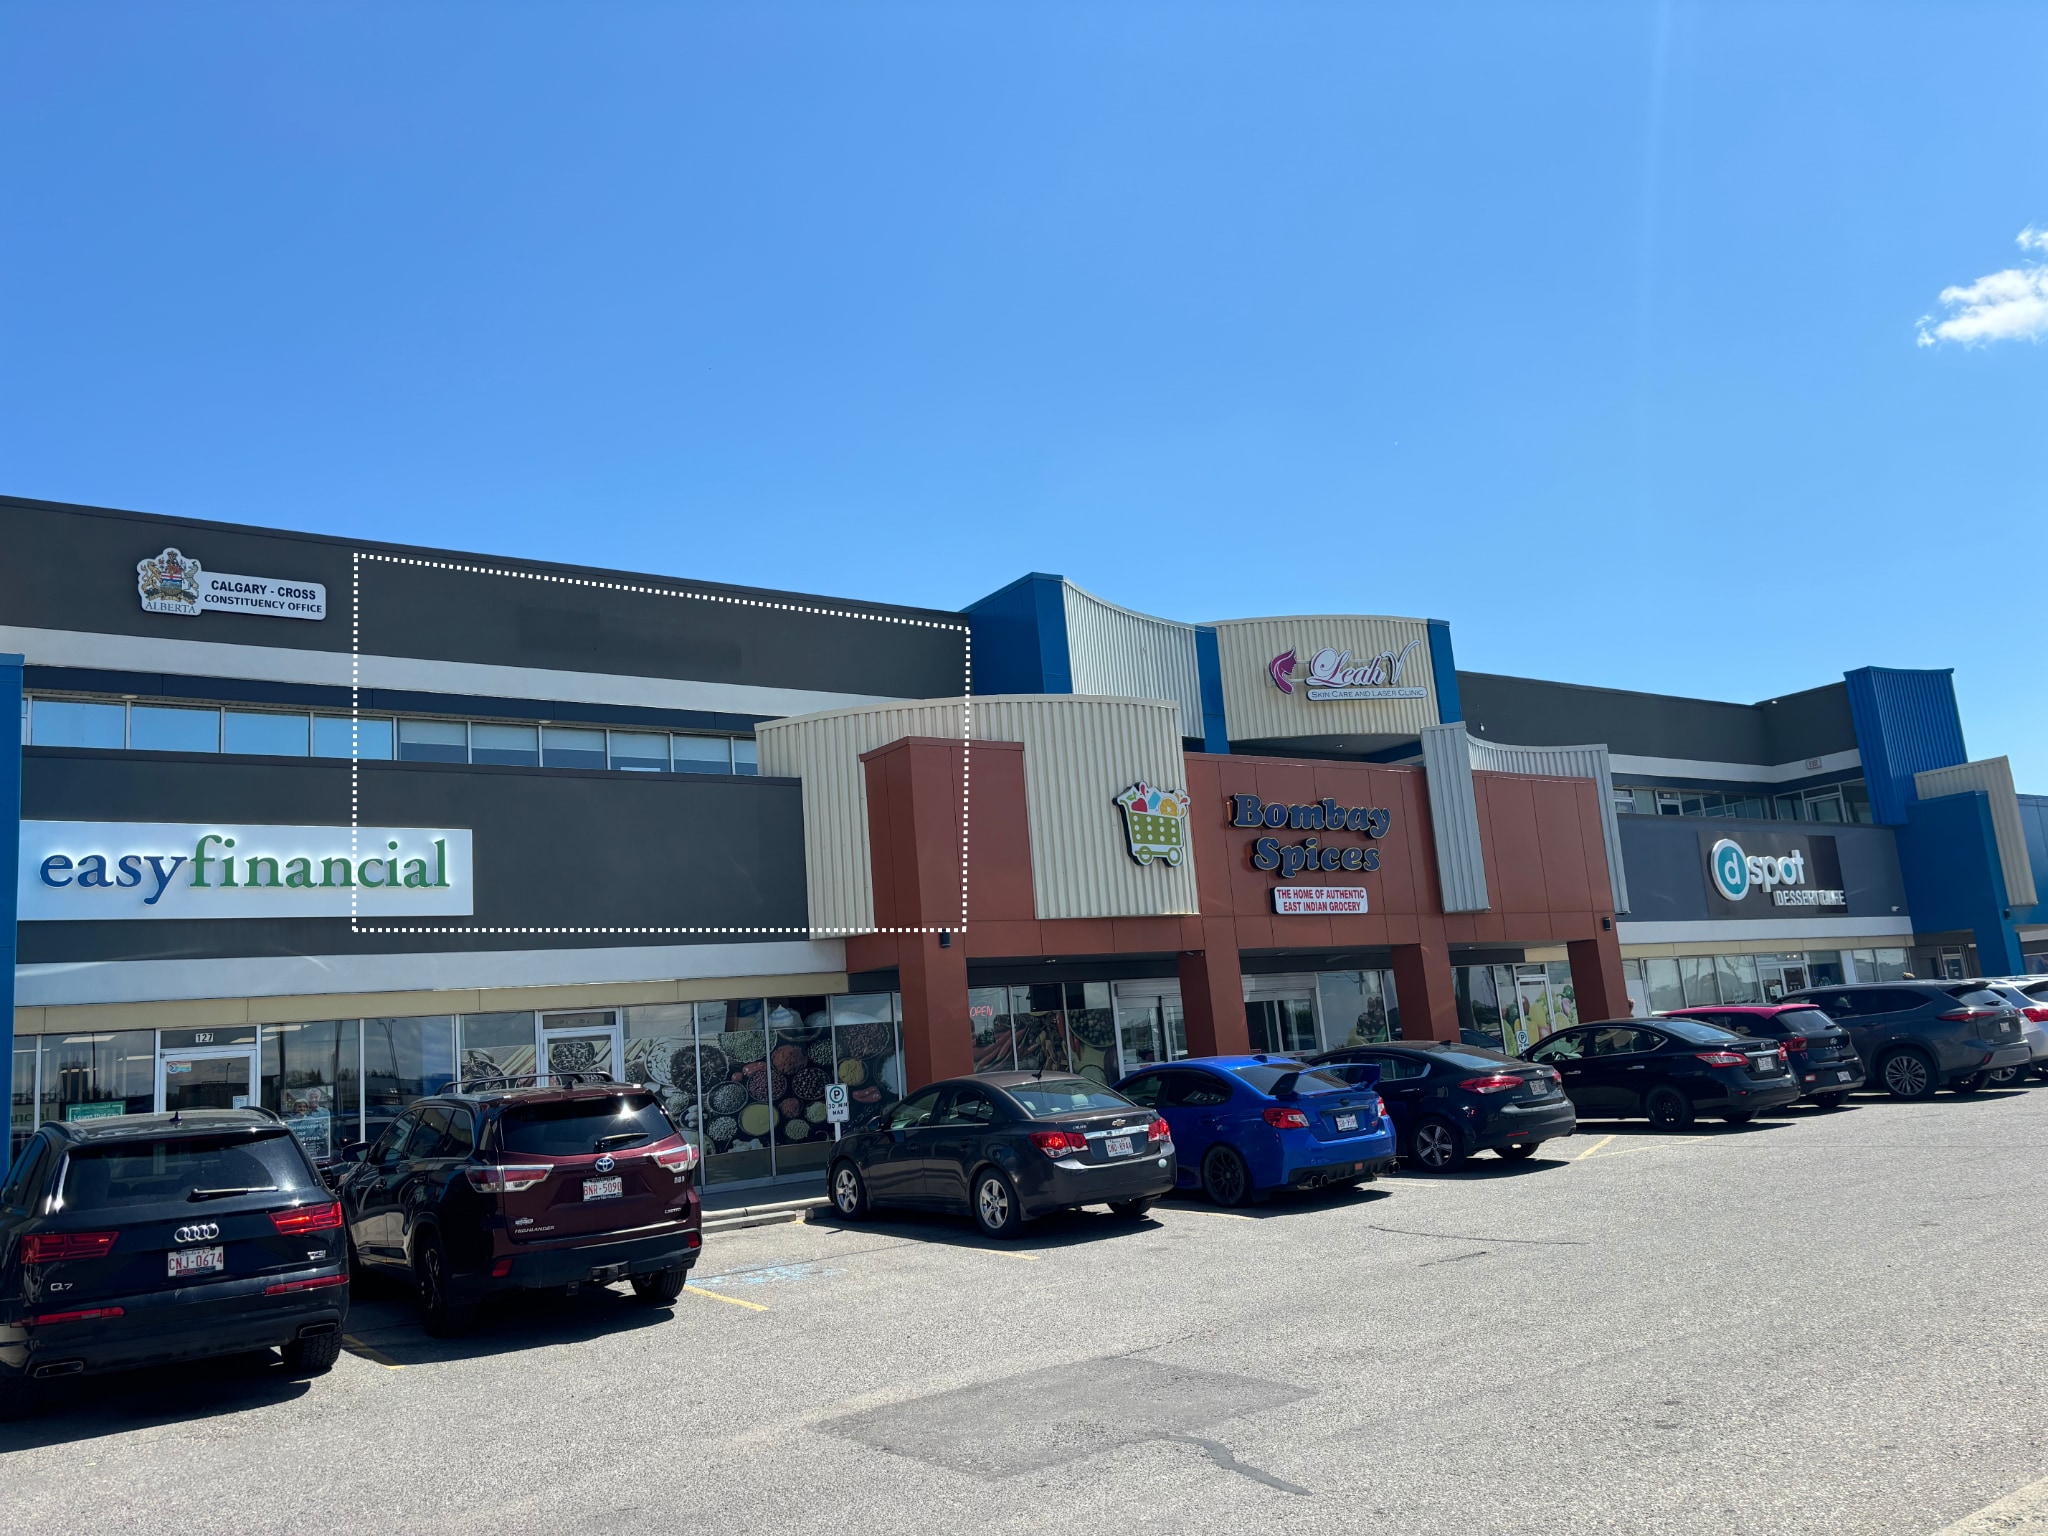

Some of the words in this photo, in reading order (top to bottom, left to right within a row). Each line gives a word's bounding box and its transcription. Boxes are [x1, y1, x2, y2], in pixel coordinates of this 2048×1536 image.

[211, 580, 267, 595] CALGARY
[277, 587, 316, 600] CROSS
[145, 601, 197, 614] ALBERTA
[204, 594, 285, 610] CONSTITUENCY
[288, 602, 323, 614] OFFICE
[1306, 647, 1386, 688] Leah
[1381, 640, 1422, 685] V
[1233, 792, 1391, 839] Bombay
[1253, 836, 1381, 879] Spices
[38, 833, 451, 906] easyfinancial
[1276, 889, 1292, 899] THE
[1293, 889, 1314, 899] HOME
[1315, 889, 1325, 899] OF
[1326, 889, 1365, 899] AUTHENTIC
[1774, 889, 1819, 906] DESSERT
[1283, 901, 1302, 912] EAST
[1303, 901, 1328, 912] INDIAN
[1329, 901, 1361, 912] GROCERY
[969, 1005, 994, 1017] OPEN
[196, 1033, 213, 1042] 127
[583, 1182, 622, 1196] BNR-5090
[514, 1225, 555, 1234] HIGHLANDER
[168, 1252, 223, 1270] CNJ-0674
[50, 1282, 73, 1291] Q7
